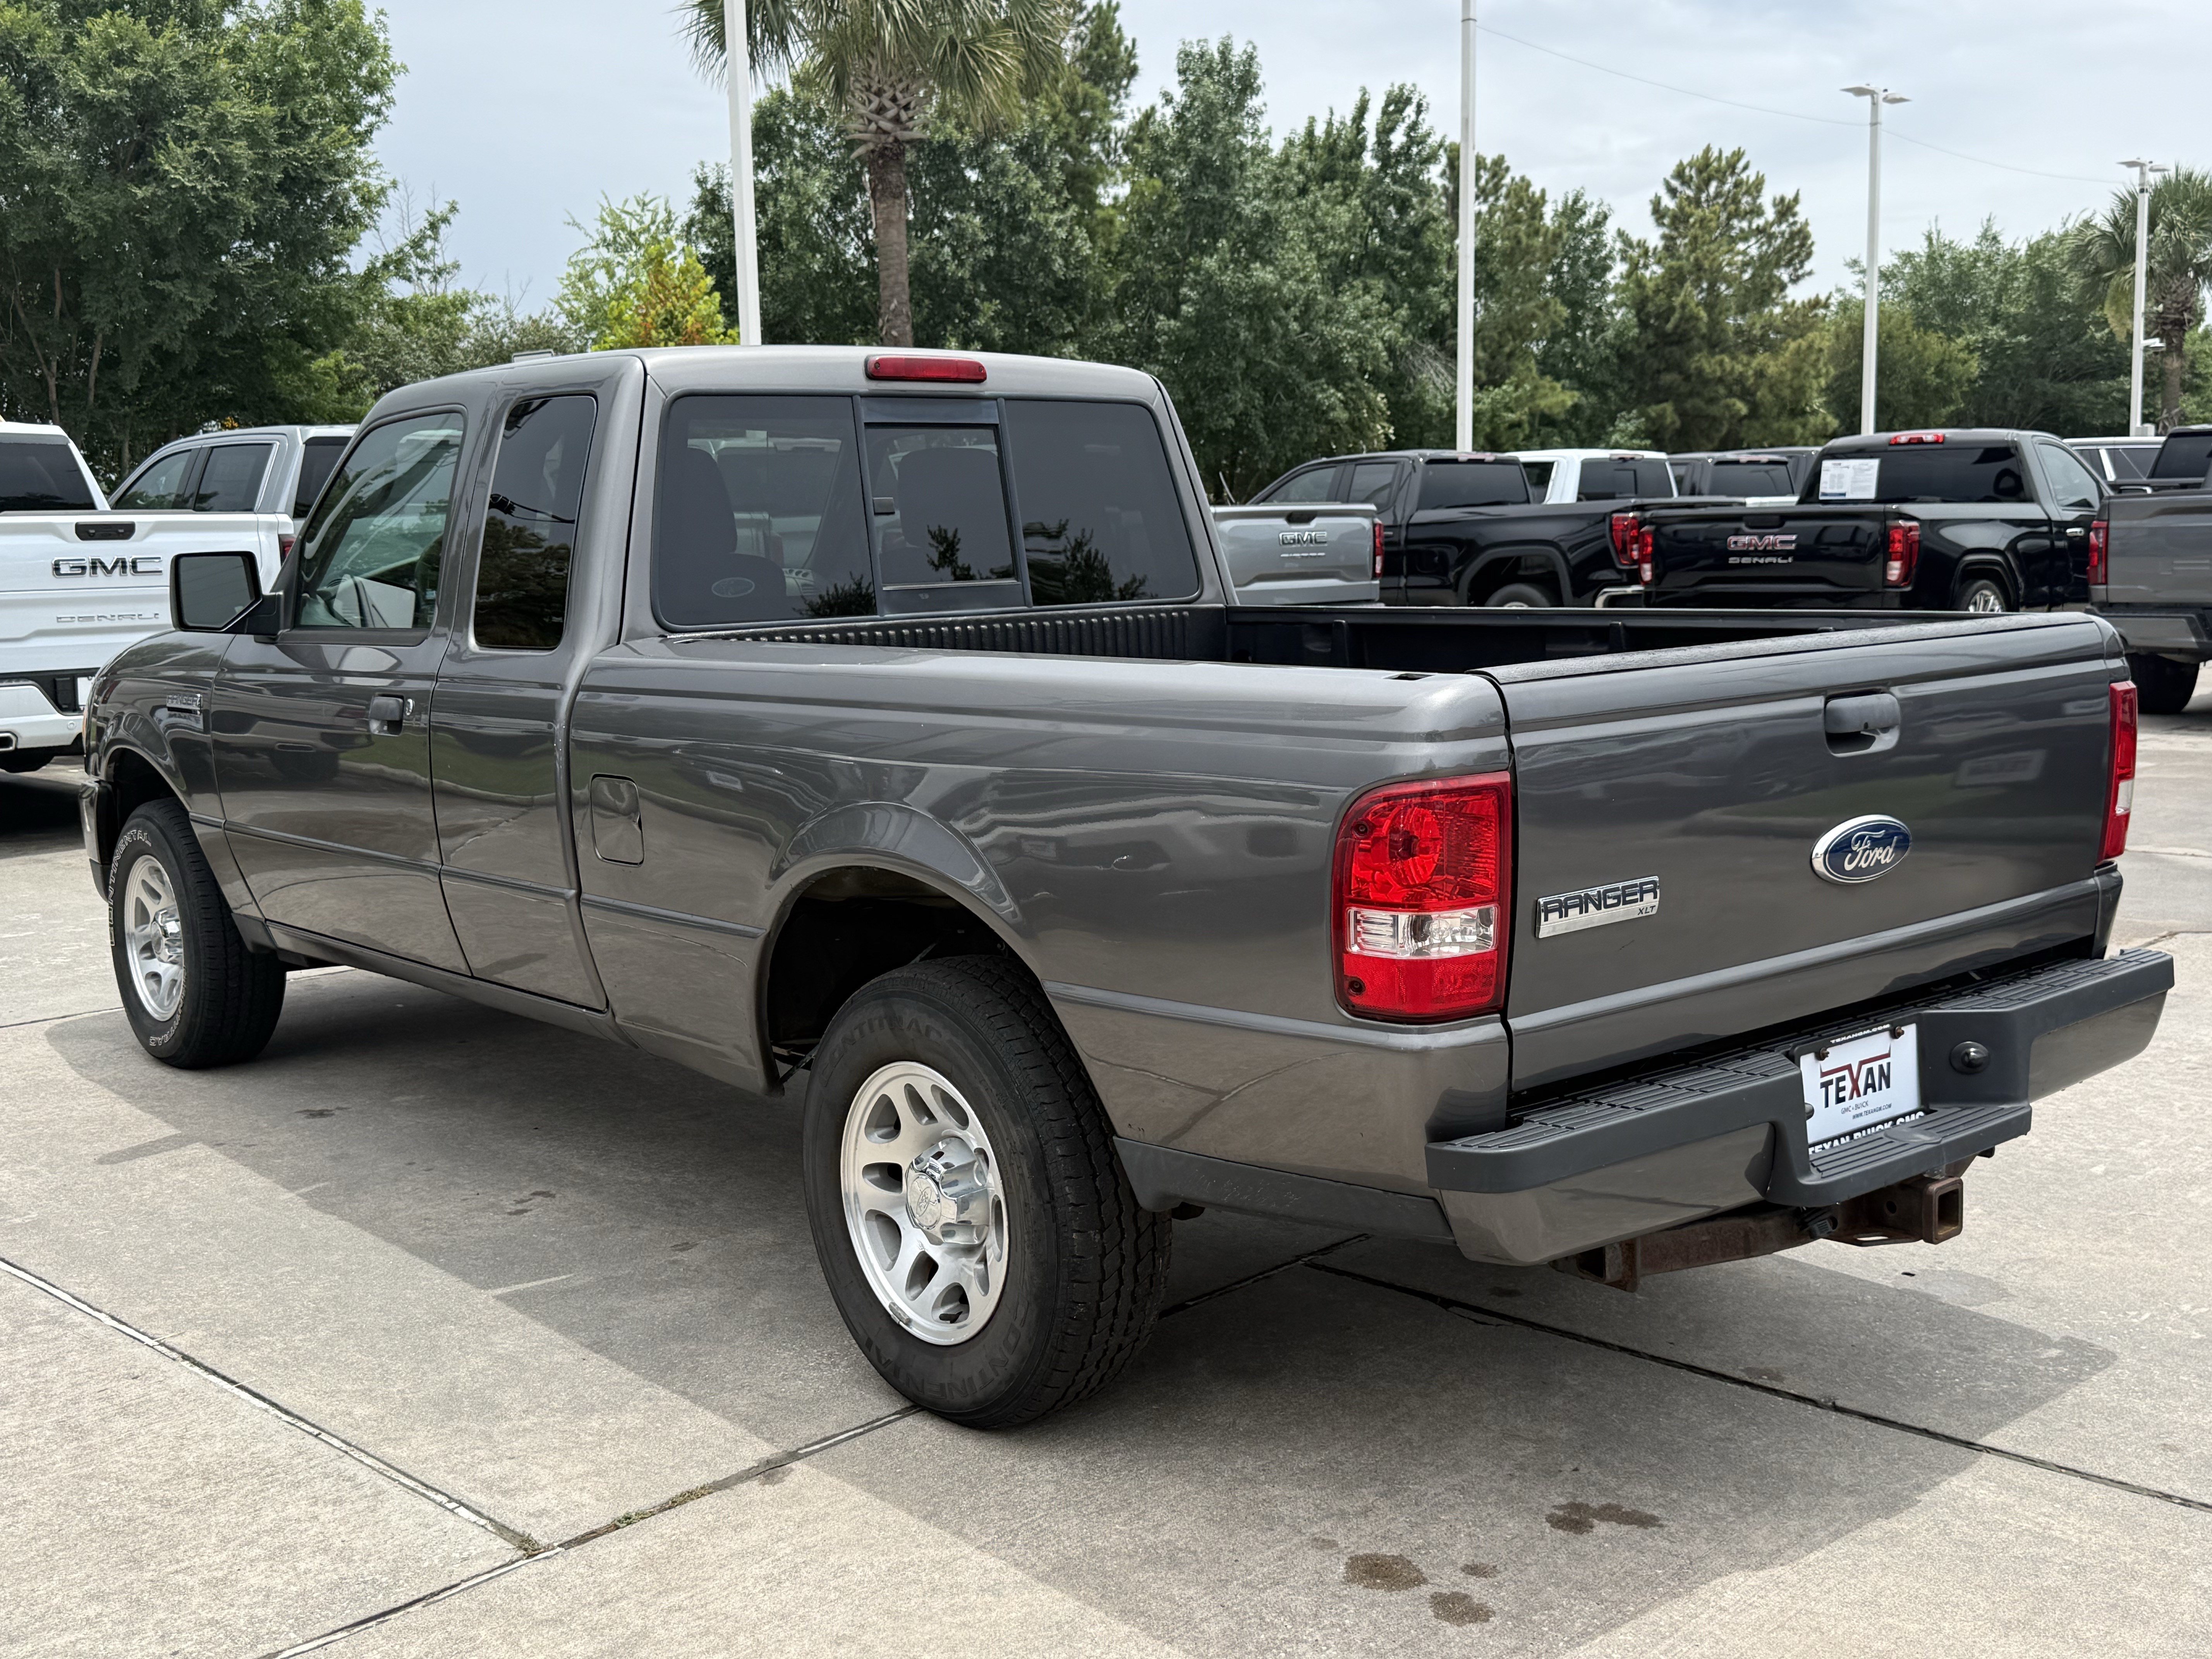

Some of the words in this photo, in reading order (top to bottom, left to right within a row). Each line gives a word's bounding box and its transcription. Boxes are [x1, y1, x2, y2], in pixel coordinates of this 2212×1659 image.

[1279, 531, 1328, 547] GMC
[1727, 535, 1798, 550] GMC
[51, 555, 163, 578] GMC
[57, 613, 159, 623] DENALI
[1844, 830, 1898, 871] Ford
[1543, 879, 1658, 922] RANGER
[1638, 905, 1656, 915] XLT
[1830, 1024, 1890, 1044] TEXANGM.COM
[1820, 1059, 1891, 1109] TEXAN
[1841, 1105, 1851, 1114] GMC
[1855, 1100, 1869, 1110] BUICK
[1853, 1103, 1892, 1120] WWW.TEXANGM.COM
